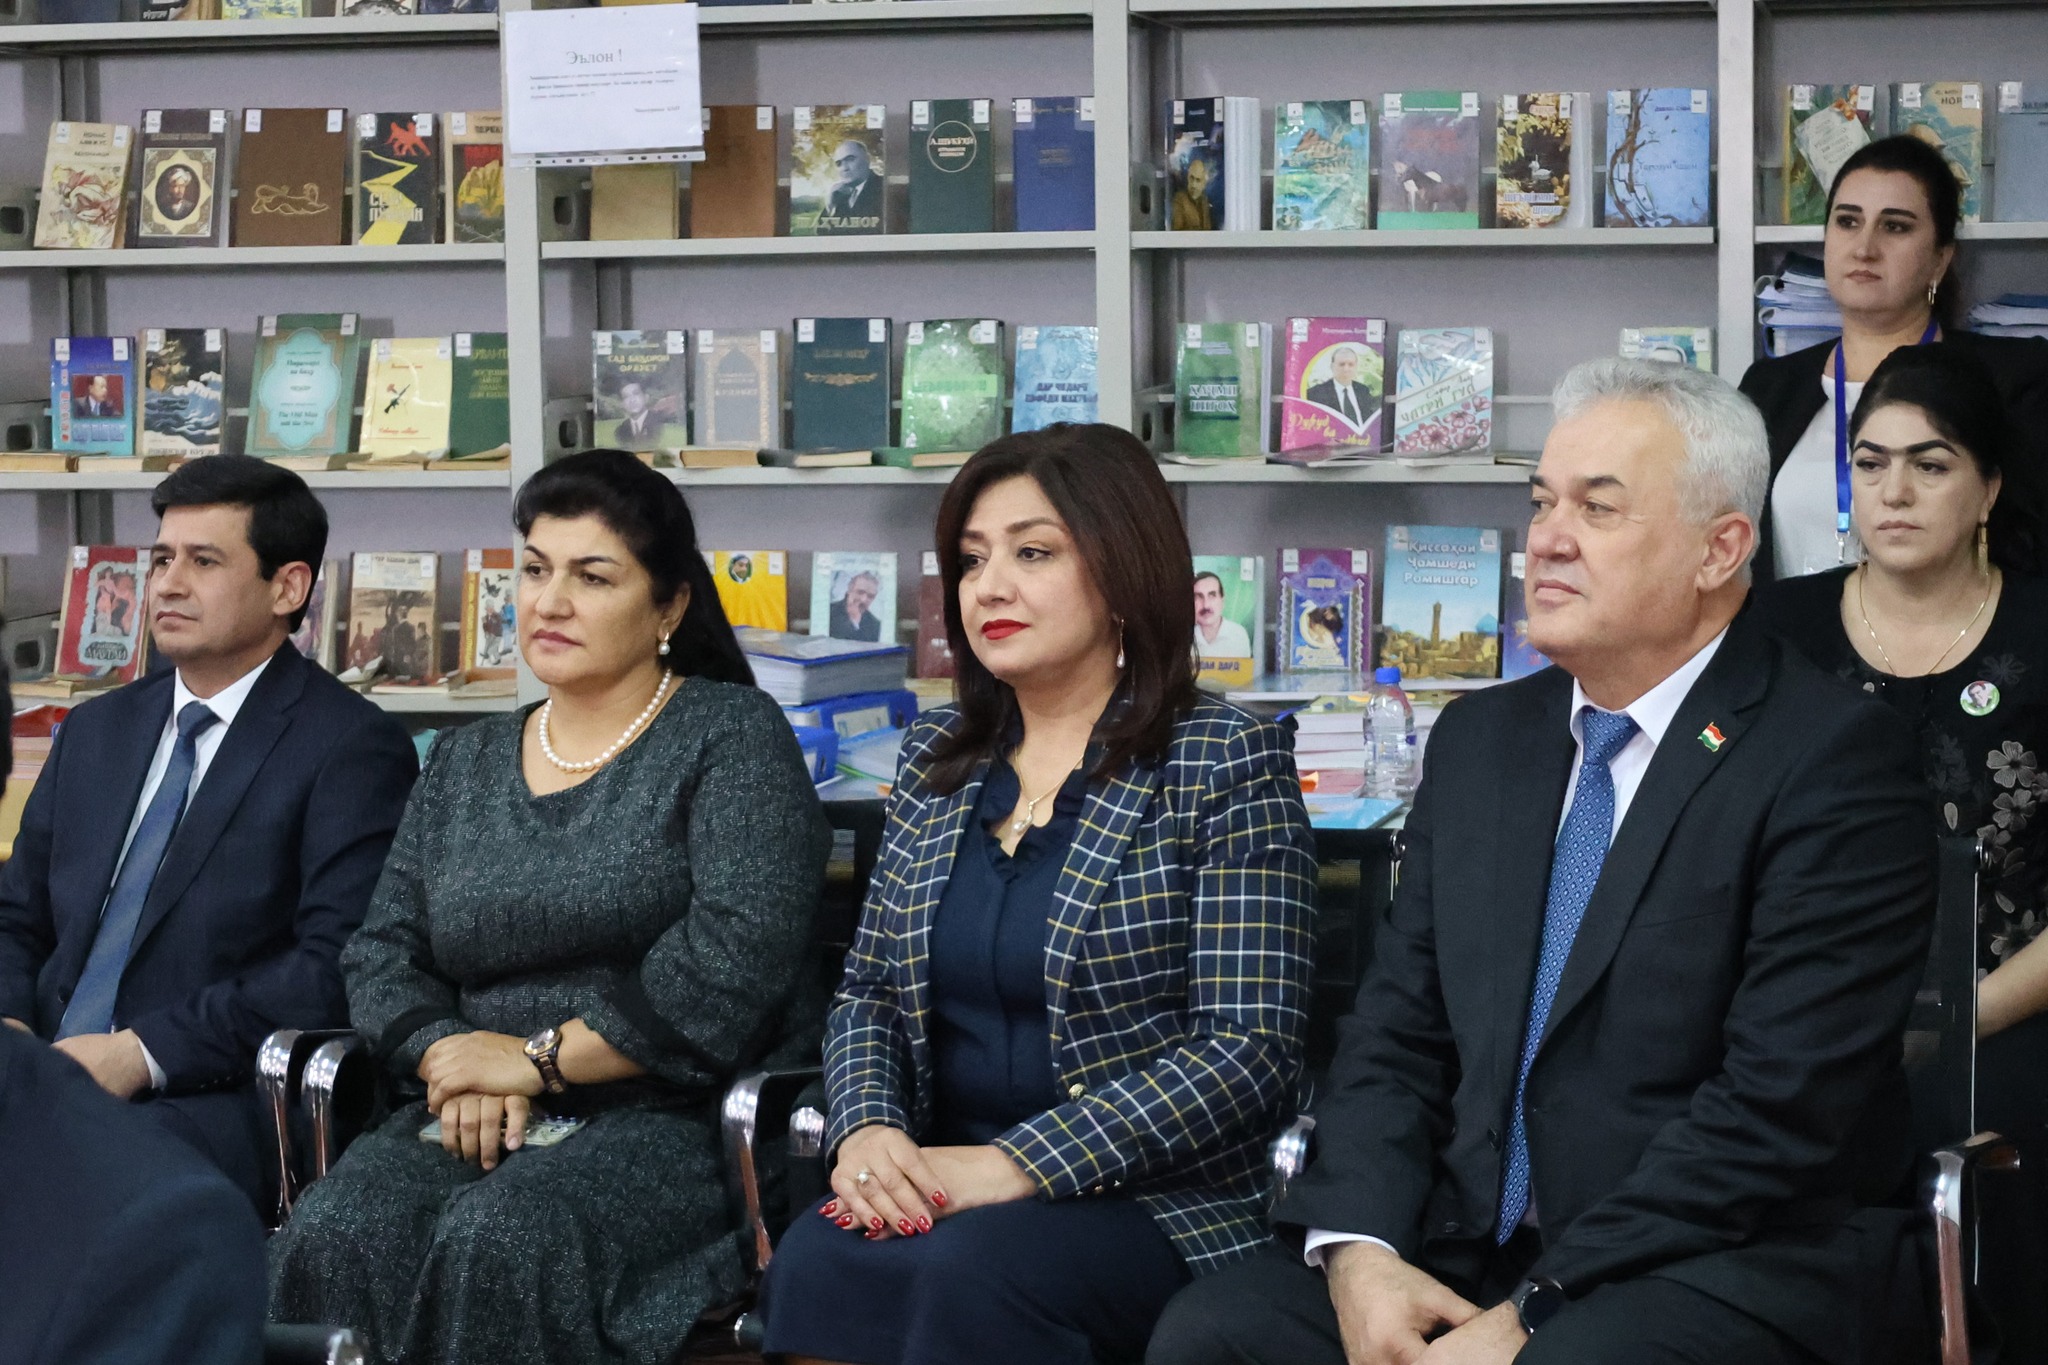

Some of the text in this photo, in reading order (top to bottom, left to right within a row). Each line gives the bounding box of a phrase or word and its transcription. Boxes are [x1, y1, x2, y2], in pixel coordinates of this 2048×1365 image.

[566, 50, 614, 65] Эълон
[1409, 541, 1476, 556] Қиссаҳои
[1408, 557, 1476, 570] Ҷамшеди
[1404, 572, 1478, 588] Ромишгар
